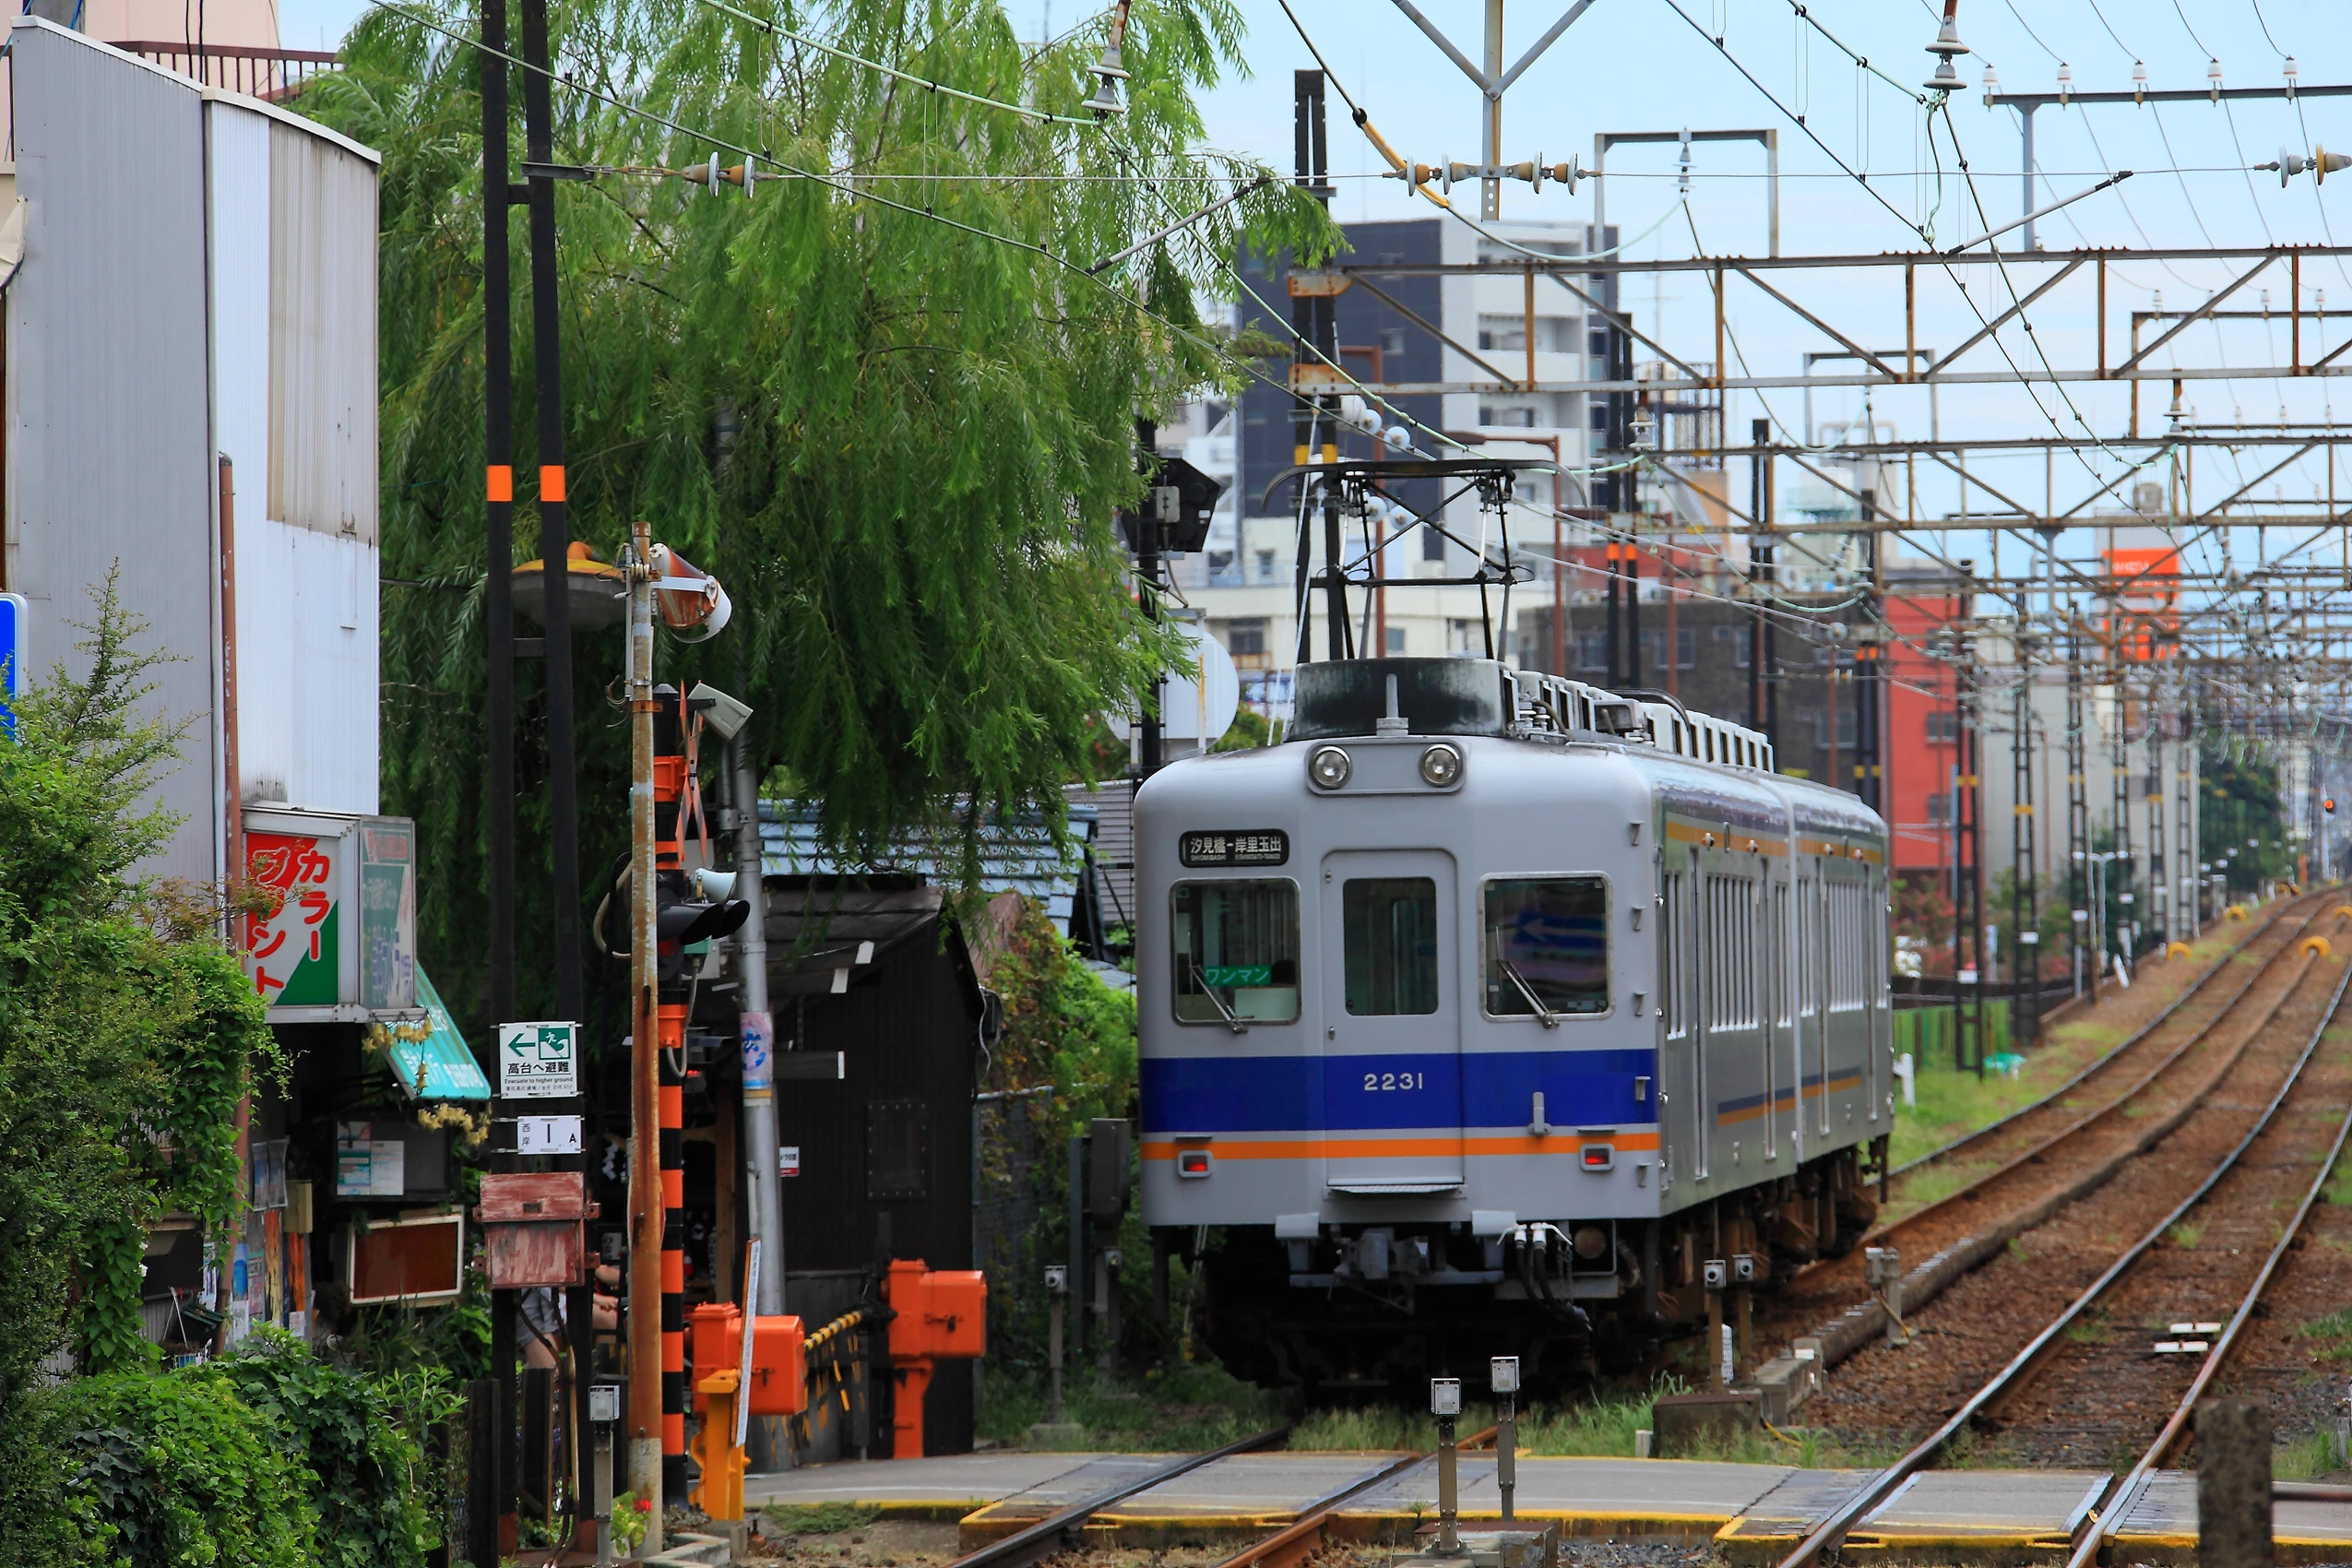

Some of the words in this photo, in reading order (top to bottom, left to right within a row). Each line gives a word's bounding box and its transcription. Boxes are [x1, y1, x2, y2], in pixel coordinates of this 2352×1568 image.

[297, 849, 330, 962] カラー
[1206, 968, 1269, 984] ワンマン
[507, 1062, 569, 1075] 高台へ避難
[1364, 1073, 1423, 1091] 2231
[569, 1133, 576, 1143] A
